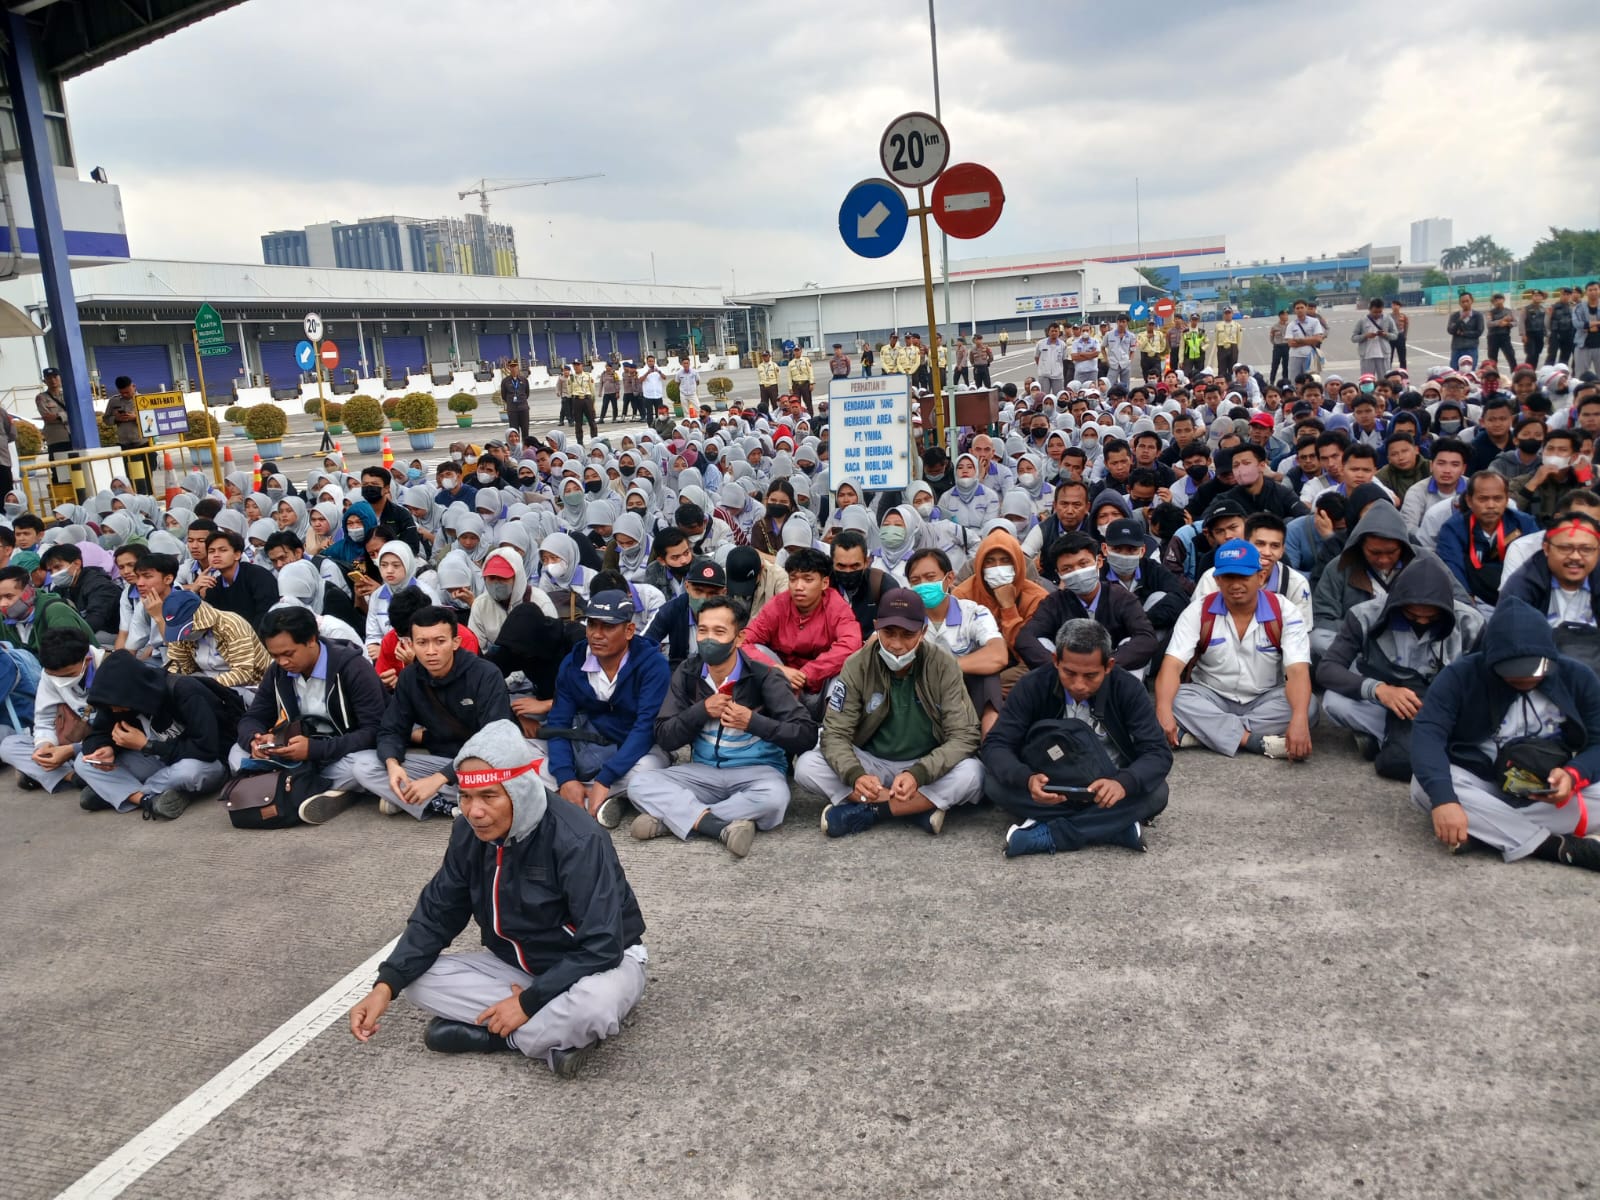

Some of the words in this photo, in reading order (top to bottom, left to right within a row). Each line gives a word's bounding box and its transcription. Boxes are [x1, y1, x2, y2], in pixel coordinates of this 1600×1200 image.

[890, 130, 924, 171] 20
[924, 133, 940, 146] km
[306, 318, 317, 333] 20
[850, 380, 880, 392] PERHATIAN
[150, 396, 175, 406] HATI-HATI
[844, 399, 875, 411] KENDARAAN
[880, 398, 894, 409] YANG
[844, 415, 871, 427] MEMASUKI
[876, 414, 892, 424] AREA
[845, 447, 860, 457] WAJIB
[865, 445, 893, 456] MEMBUKA
[844, 462, 860, 472] KACA
[865, 461, 881, 471] MOBIL
[881, 460, 893, 470] DAN
[869, 474, 887, 485] HELM
